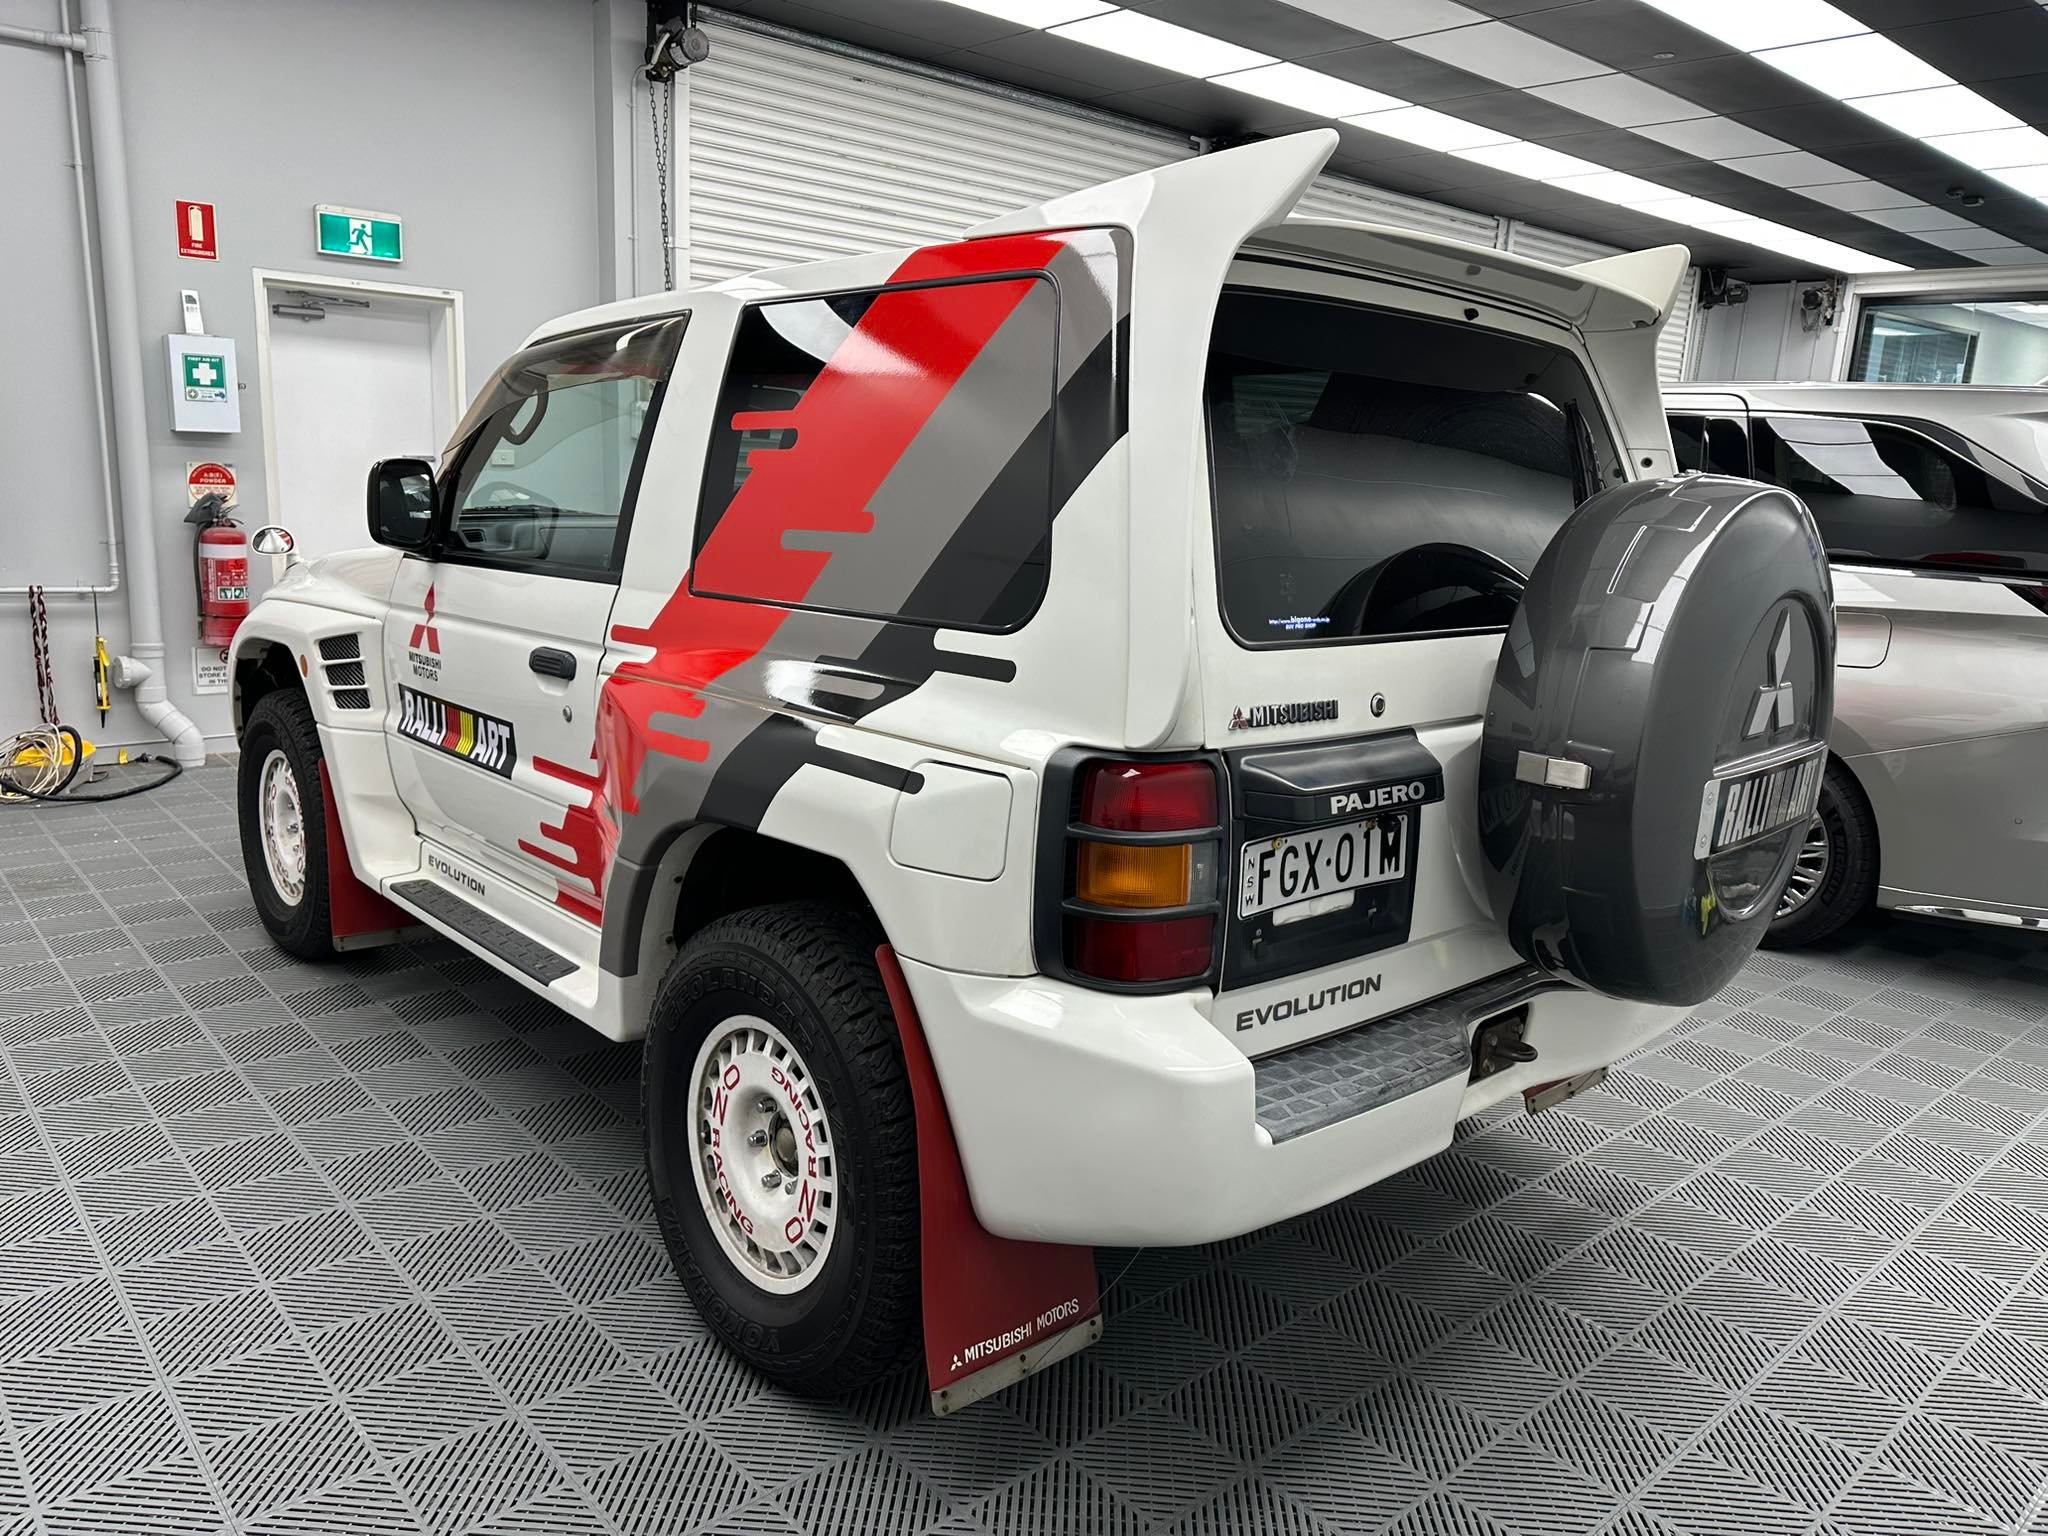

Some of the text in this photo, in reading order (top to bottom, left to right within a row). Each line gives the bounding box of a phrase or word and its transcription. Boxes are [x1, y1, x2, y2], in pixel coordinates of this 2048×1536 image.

[180, 247, 215, 257] EXTINGUISHER
[408, 650, 442, 671] MITSUBISHI
[412, 664, 439, 682] MOTORS
[1249, 700, 1339, 728] MITSUBISHI
[1330, 781, 1426, 815] PAJERO
[428, 854, 486, 896] EVOLUTION
[1236, 974, 1382, 1032] EVOLUTION
[770, 1065, 818, 1180] RACING
[711, 1127, 755, 1237] RACING
[964, 1298, 1080, 1364] MITSUBISHI MOTORS
